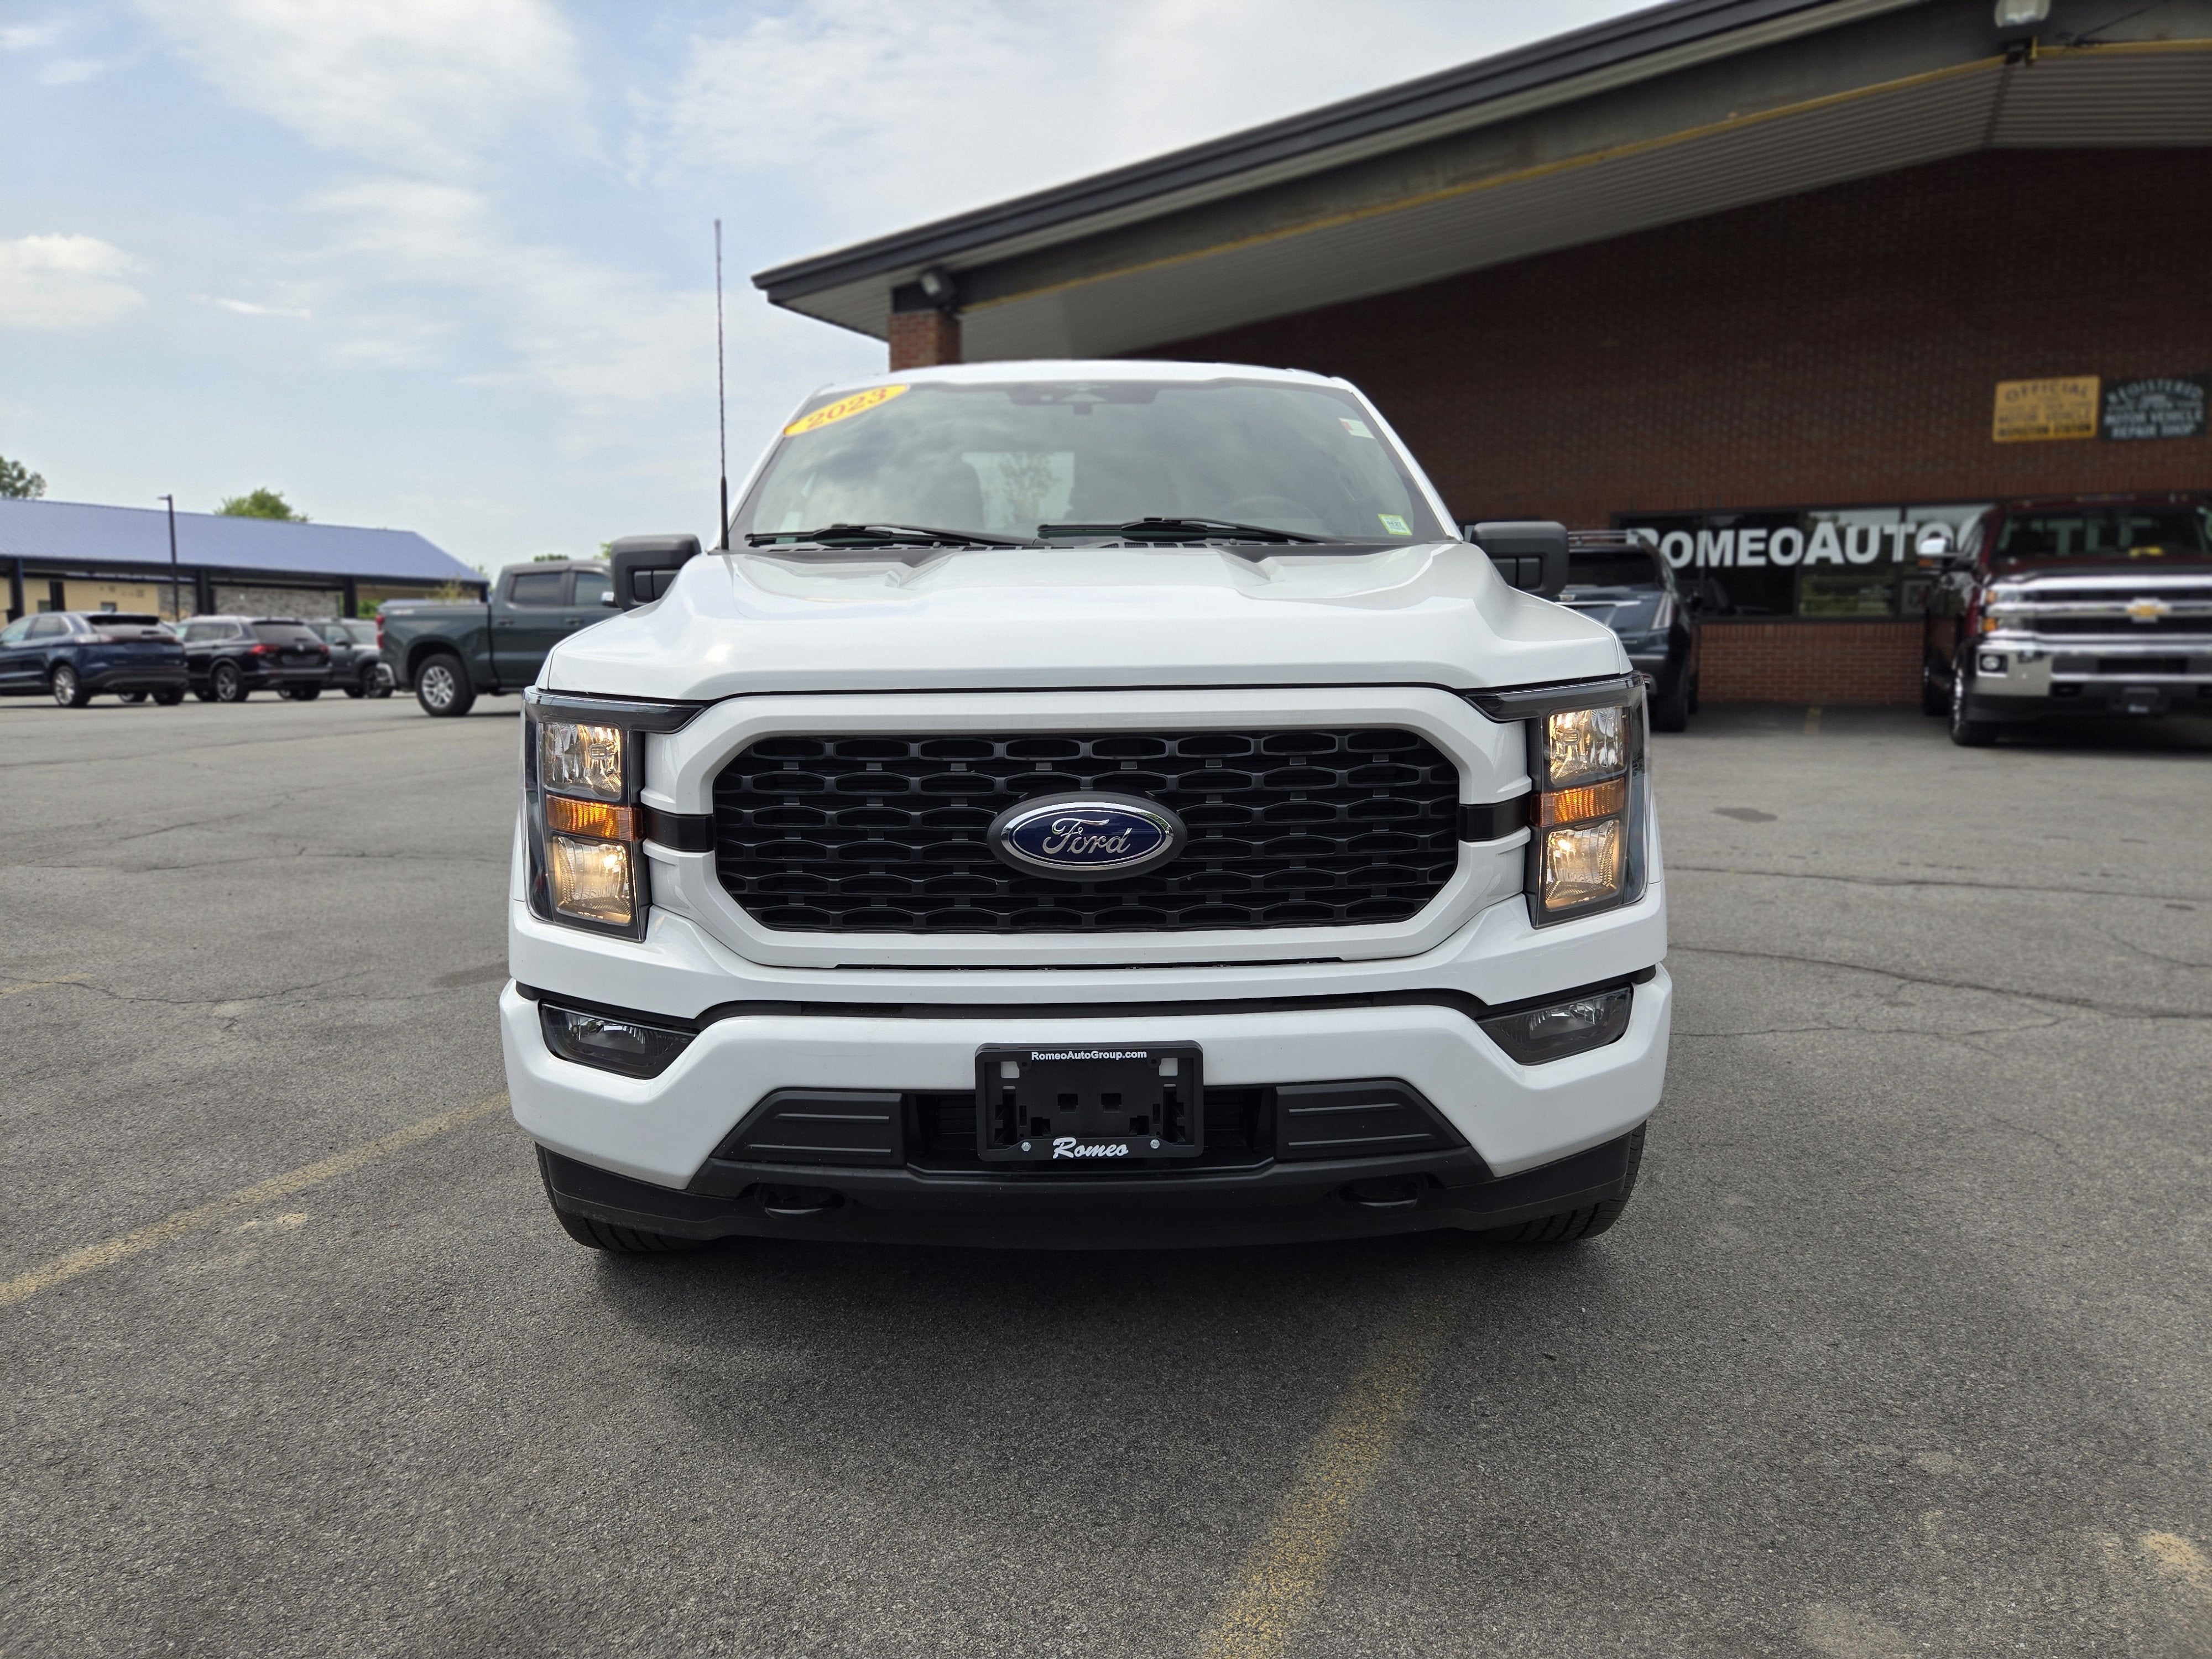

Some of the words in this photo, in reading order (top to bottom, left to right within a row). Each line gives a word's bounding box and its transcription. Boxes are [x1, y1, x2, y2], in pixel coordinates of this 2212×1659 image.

[807, 388, 886, 429] 2023
[1042, 818, 1133, 854] Ford
[1031, 1051, 1147, 1061] RomeoAutoGroup.com
[1052, 1137, 1129, 1159] Romeo
